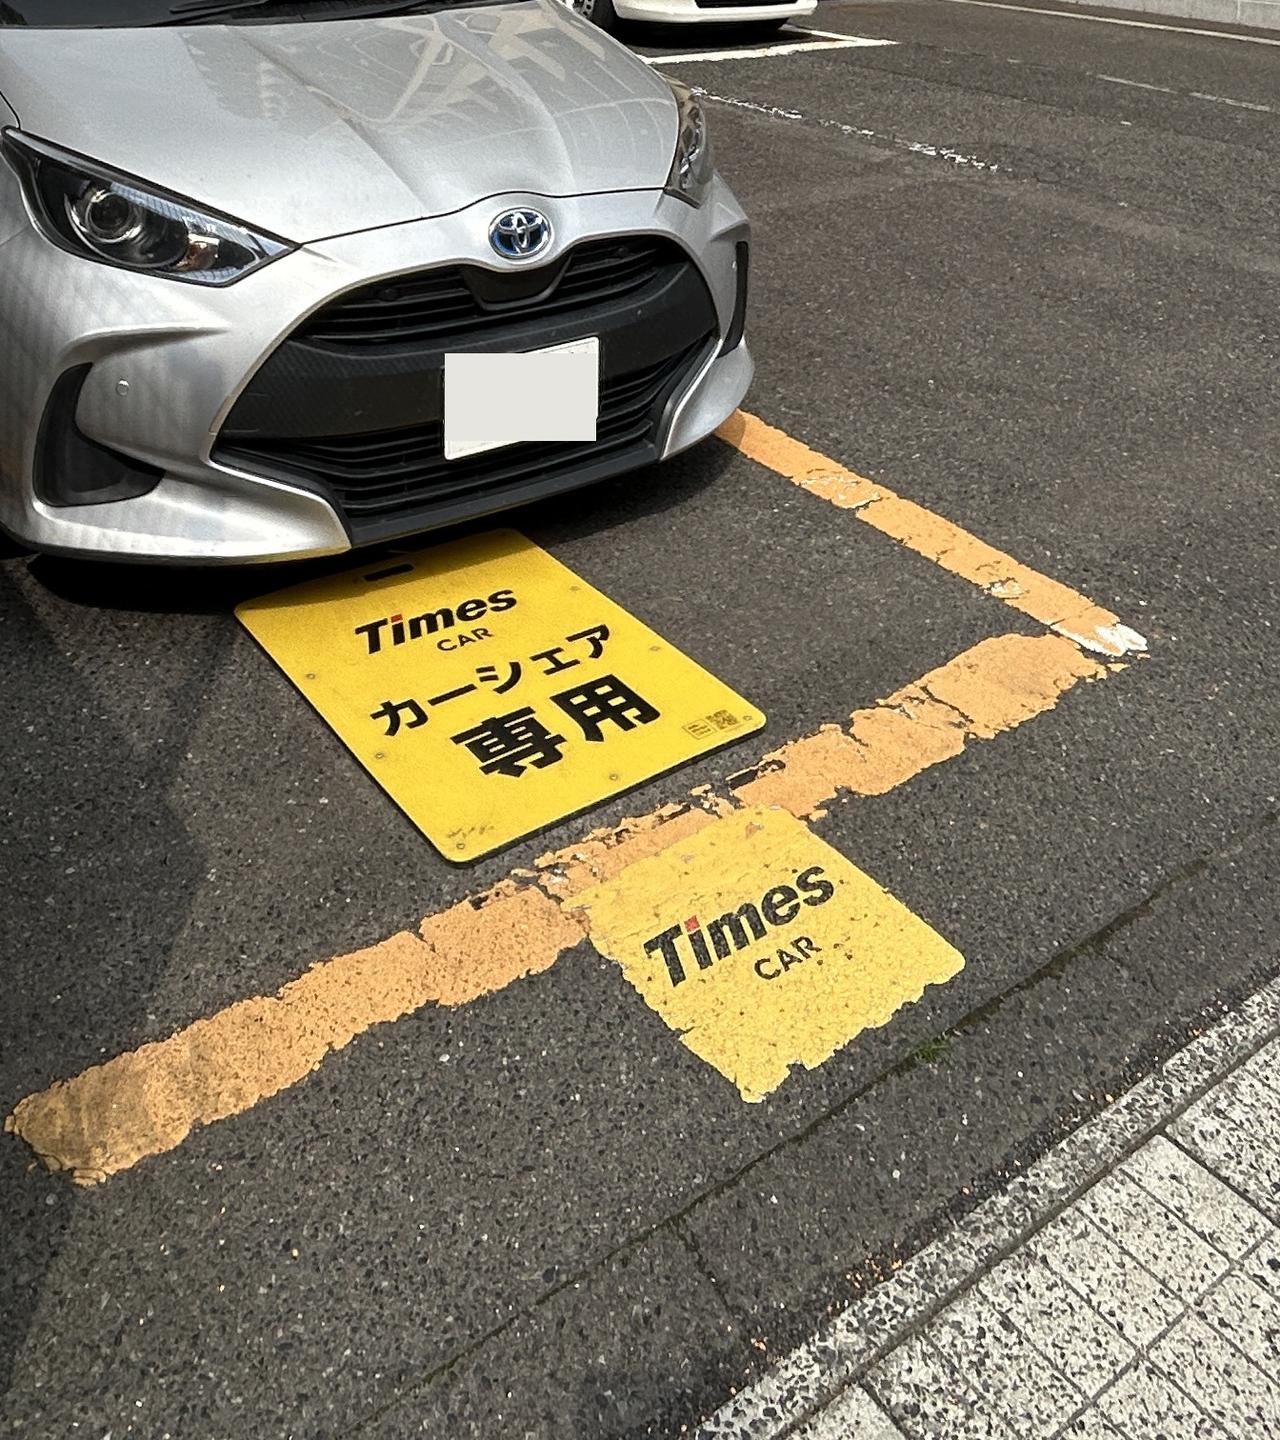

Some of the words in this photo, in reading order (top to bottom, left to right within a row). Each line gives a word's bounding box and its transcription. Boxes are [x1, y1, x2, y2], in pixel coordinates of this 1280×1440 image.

[355, 588, 519, 655] Times
[435, 626, 495, 653] CAR
[370, 623, 612, 736] カーシェア
[450, 674, 662, 778] 専用
[643, 864, 838, 988] Times
[753, 935, 822, 981] CAR
